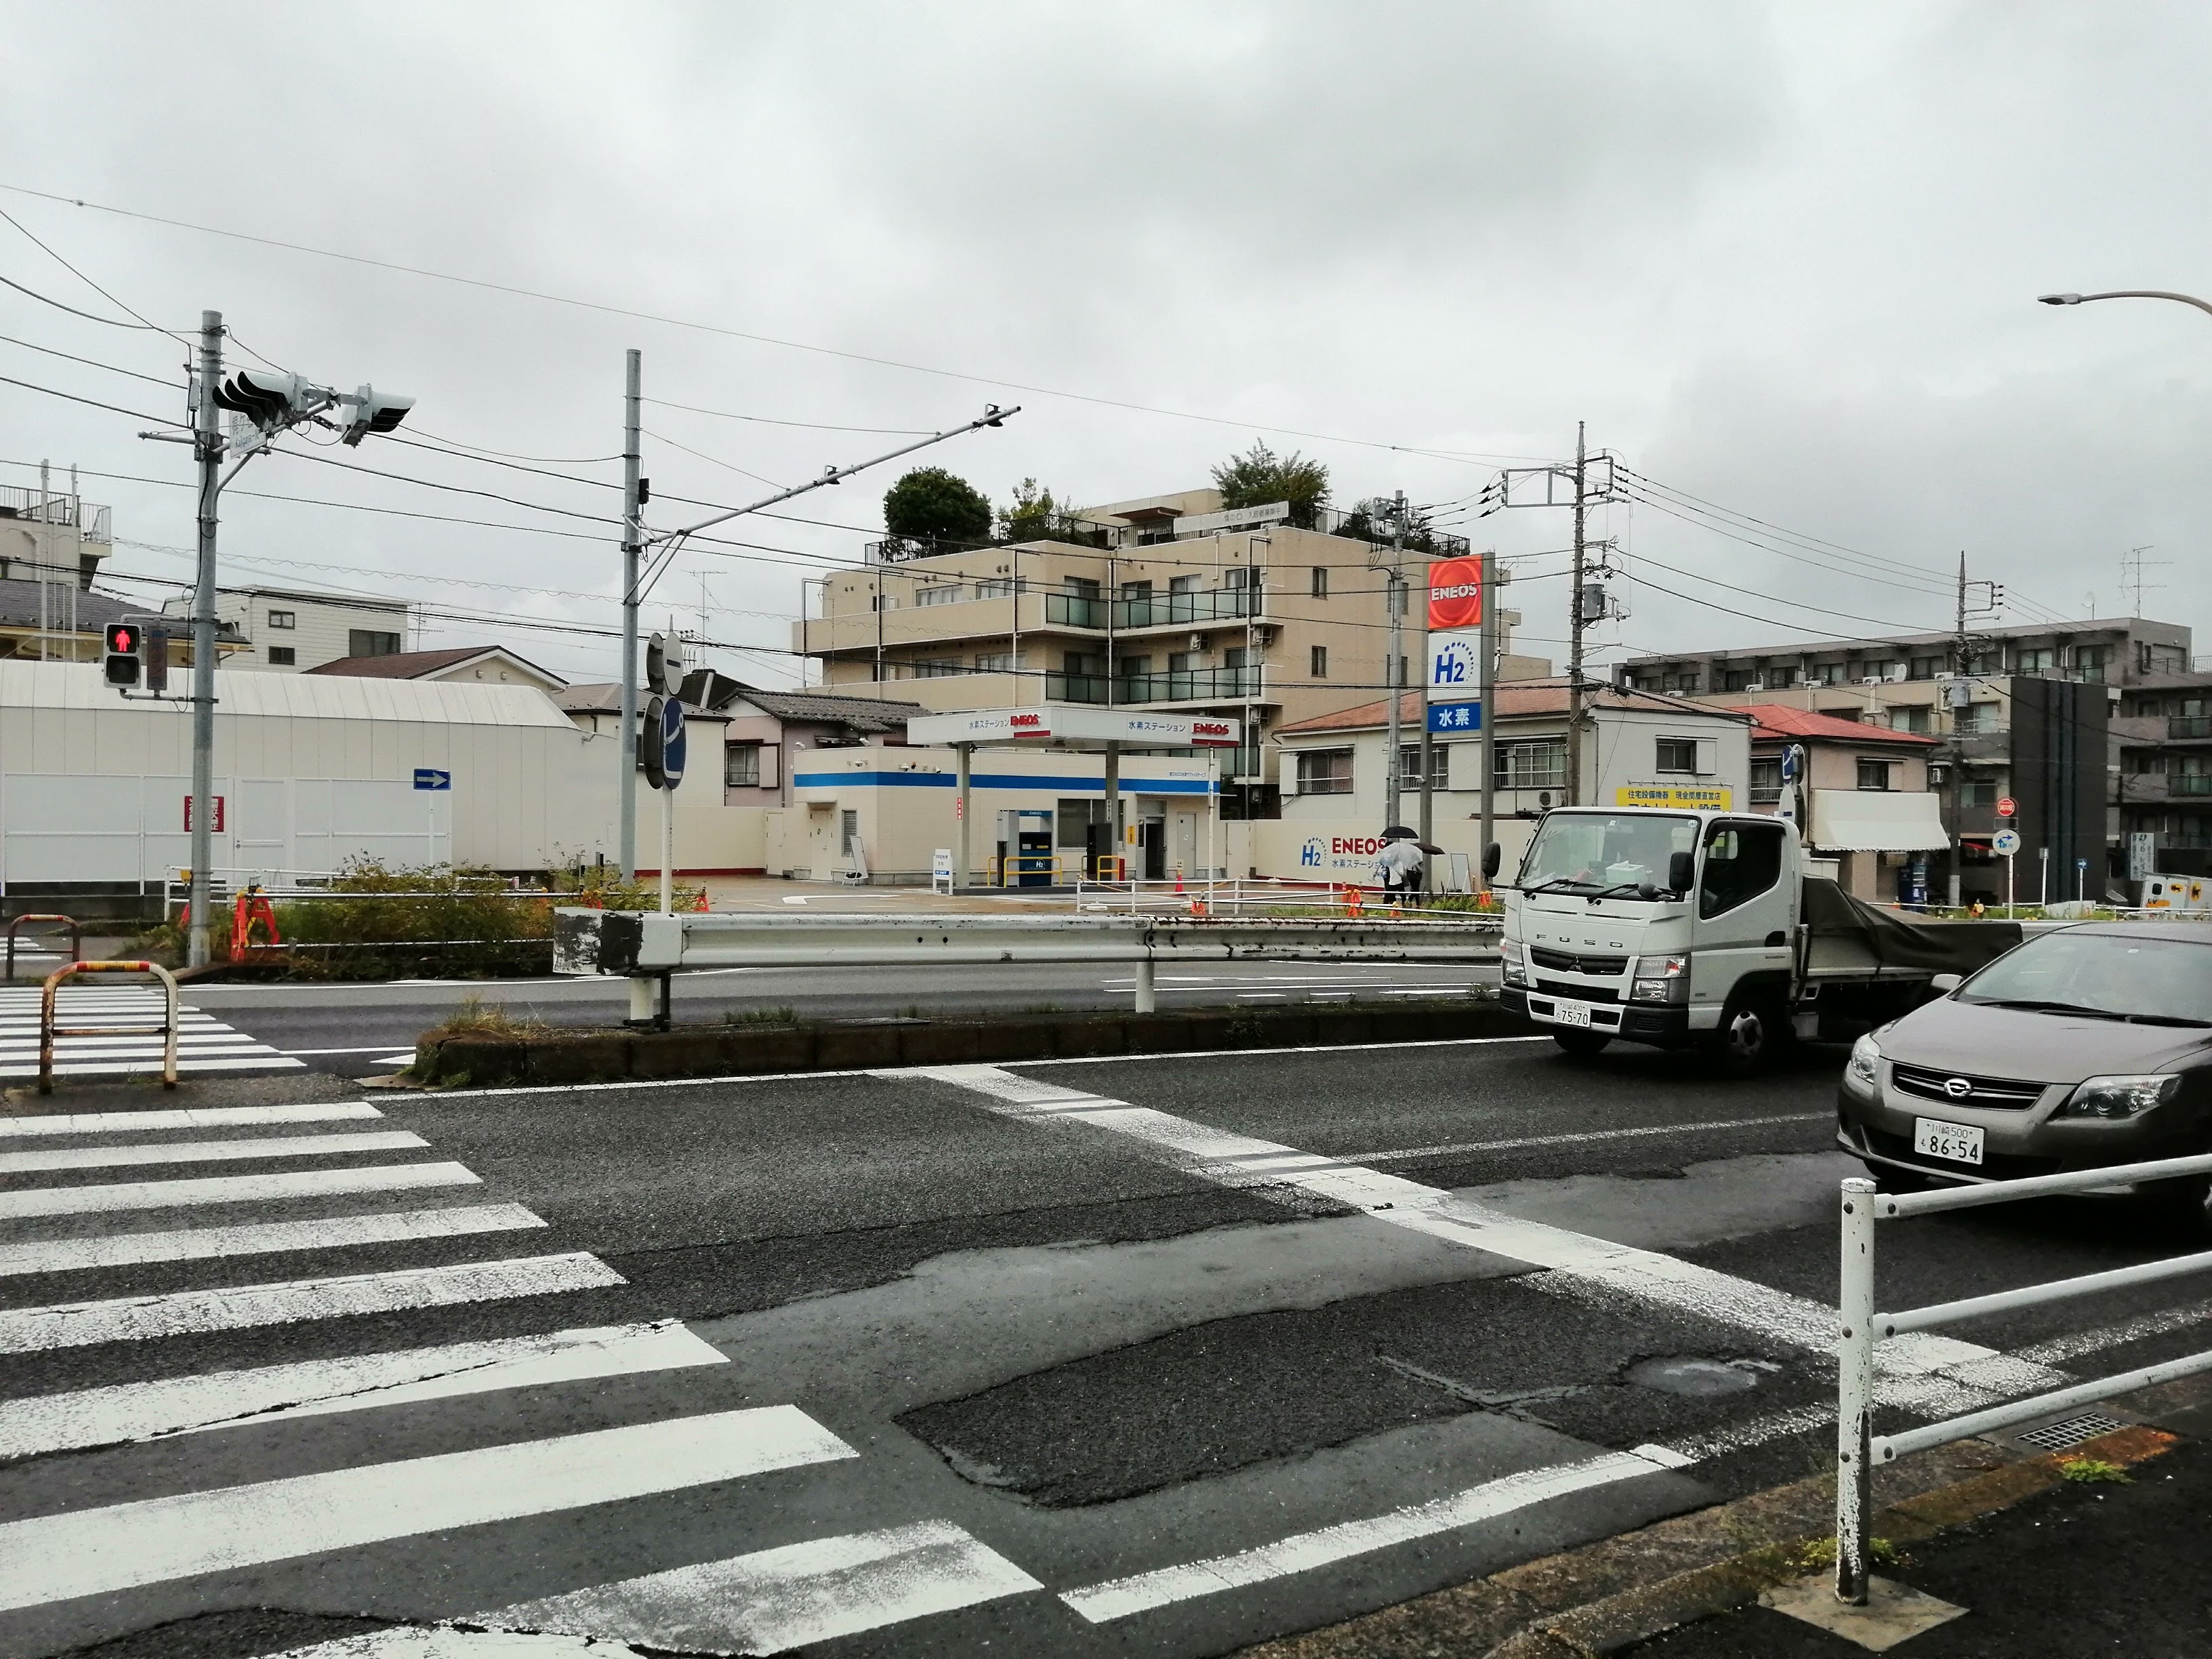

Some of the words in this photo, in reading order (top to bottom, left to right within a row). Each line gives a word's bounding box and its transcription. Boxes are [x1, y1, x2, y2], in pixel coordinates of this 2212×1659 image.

[1431, 582, 1478, 601] ENEOS
[1434, 653, 1465, 684] H2
[969, 720, 1009, 729] 水素ステーション
[1010, 714, 1041, 726] ENEOS
[1439, 708, 1470, 727] 水素
[1128, 720, 1186, 733] 水素ステーション
[1193, 722, 1229, 735] ENEOS
[1628, 790, 1669, 800] 住宅設備機器
[1301, 844, 1321, 867] H2
[1332, 837, 1387, 856] ENEOS
[1332, 859, 1381, 869] 水素ステーショ
[1536, 933, 1624, 948] FUSO
[1561, 1010, 1588, 1025] 75-70
[1921, 1137, 1926, 1147] も
[1930, 1136, 1978, 1160] 86-54
